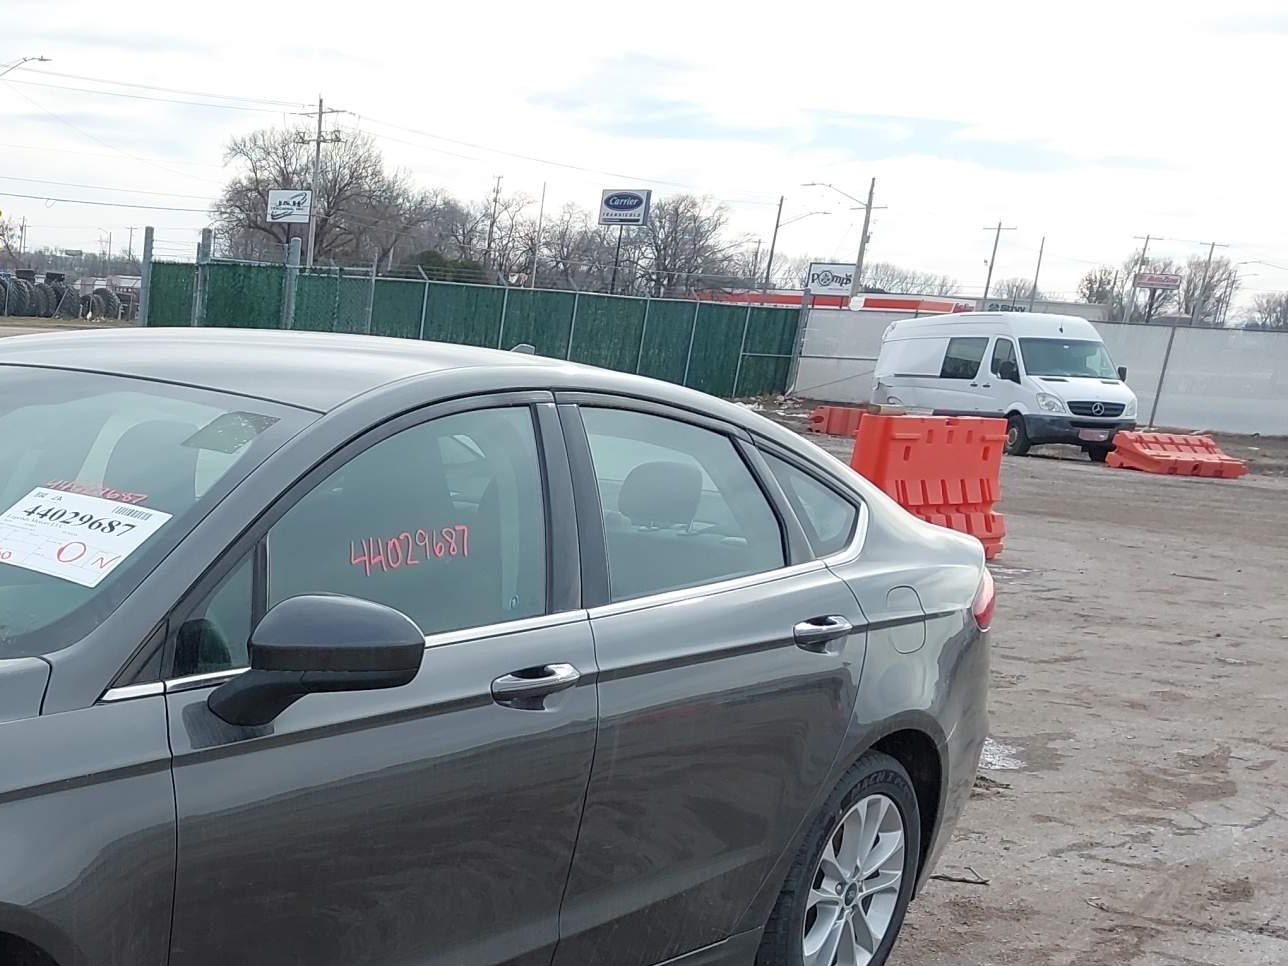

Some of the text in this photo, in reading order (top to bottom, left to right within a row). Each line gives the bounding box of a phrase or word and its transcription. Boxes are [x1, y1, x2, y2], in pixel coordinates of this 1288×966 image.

[609, 196, 640, 206] Carrier
[24, 504, 136, 537] 44029687
[350, 524, 469, 576] 44029687
